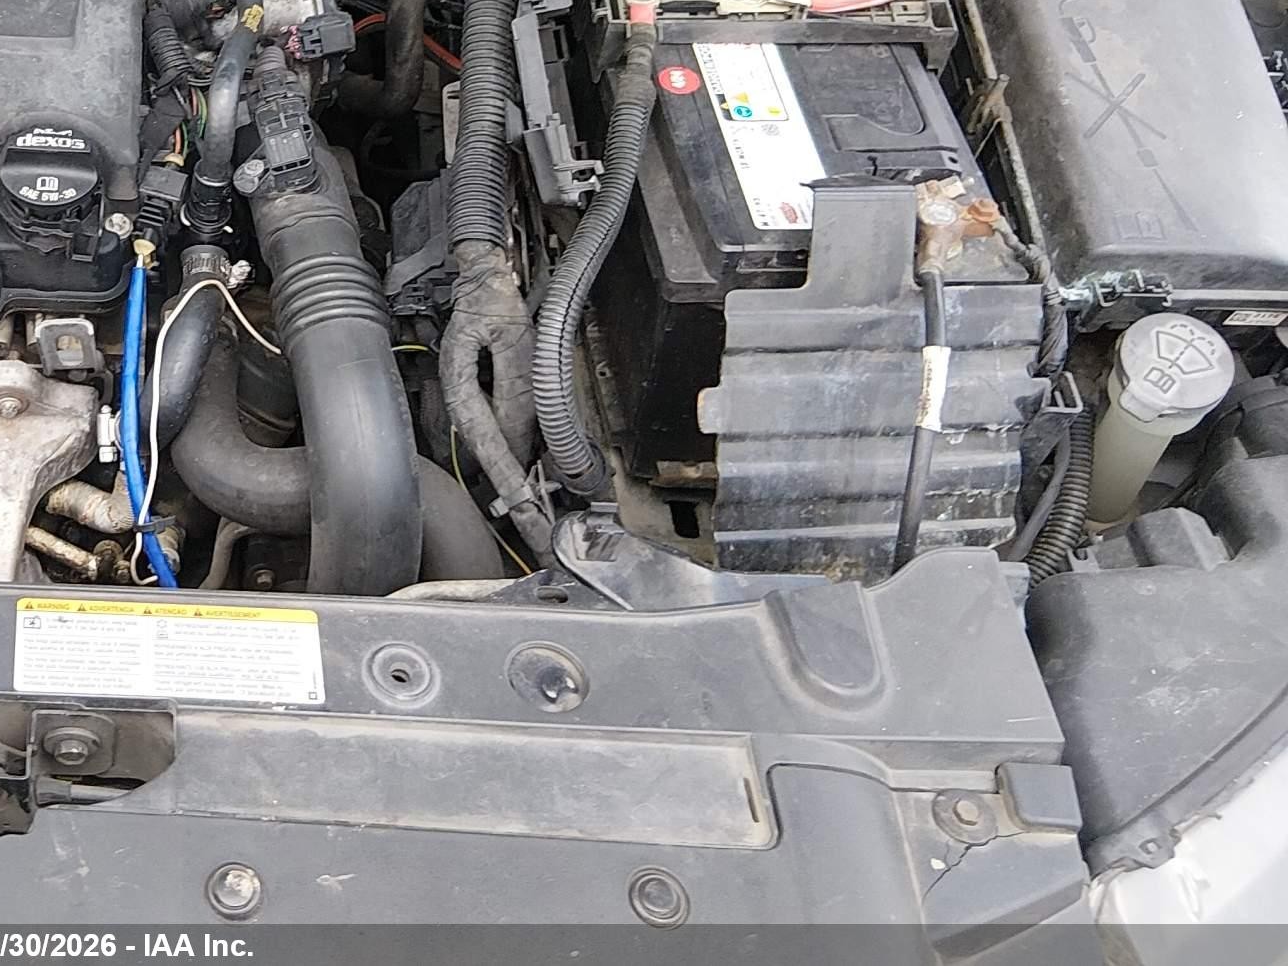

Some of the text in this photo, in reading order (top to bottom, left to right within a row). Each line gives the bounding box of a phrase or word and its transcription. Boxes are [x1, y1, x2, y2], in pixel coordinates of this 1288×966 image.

[16, 133, 86, 150] dexos
[18, 186, 78, 202] SAE 5W-30
